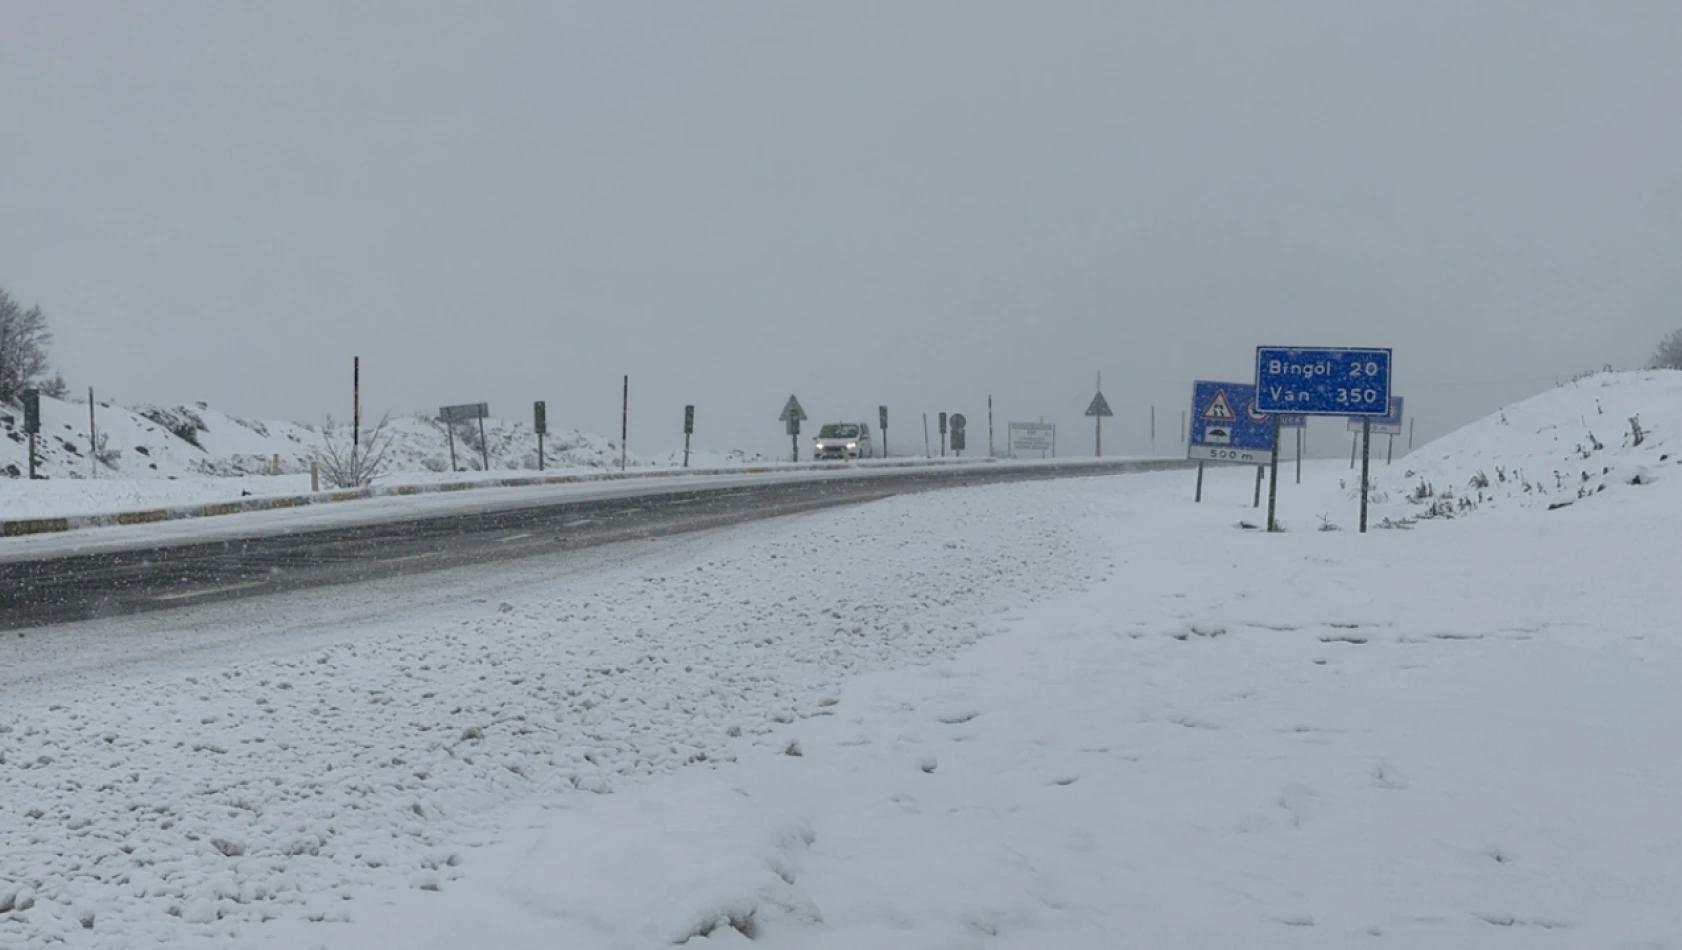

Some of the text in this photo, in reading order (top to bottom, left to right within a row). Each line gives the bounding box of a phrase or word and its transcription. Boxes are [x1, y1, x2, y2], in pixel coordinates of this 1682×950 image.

[1269, 360, 1378, 378] Bingöl 20
[1269, 386, 1377, 403] Van 350
[1210, 449, 1237, 459] 500
